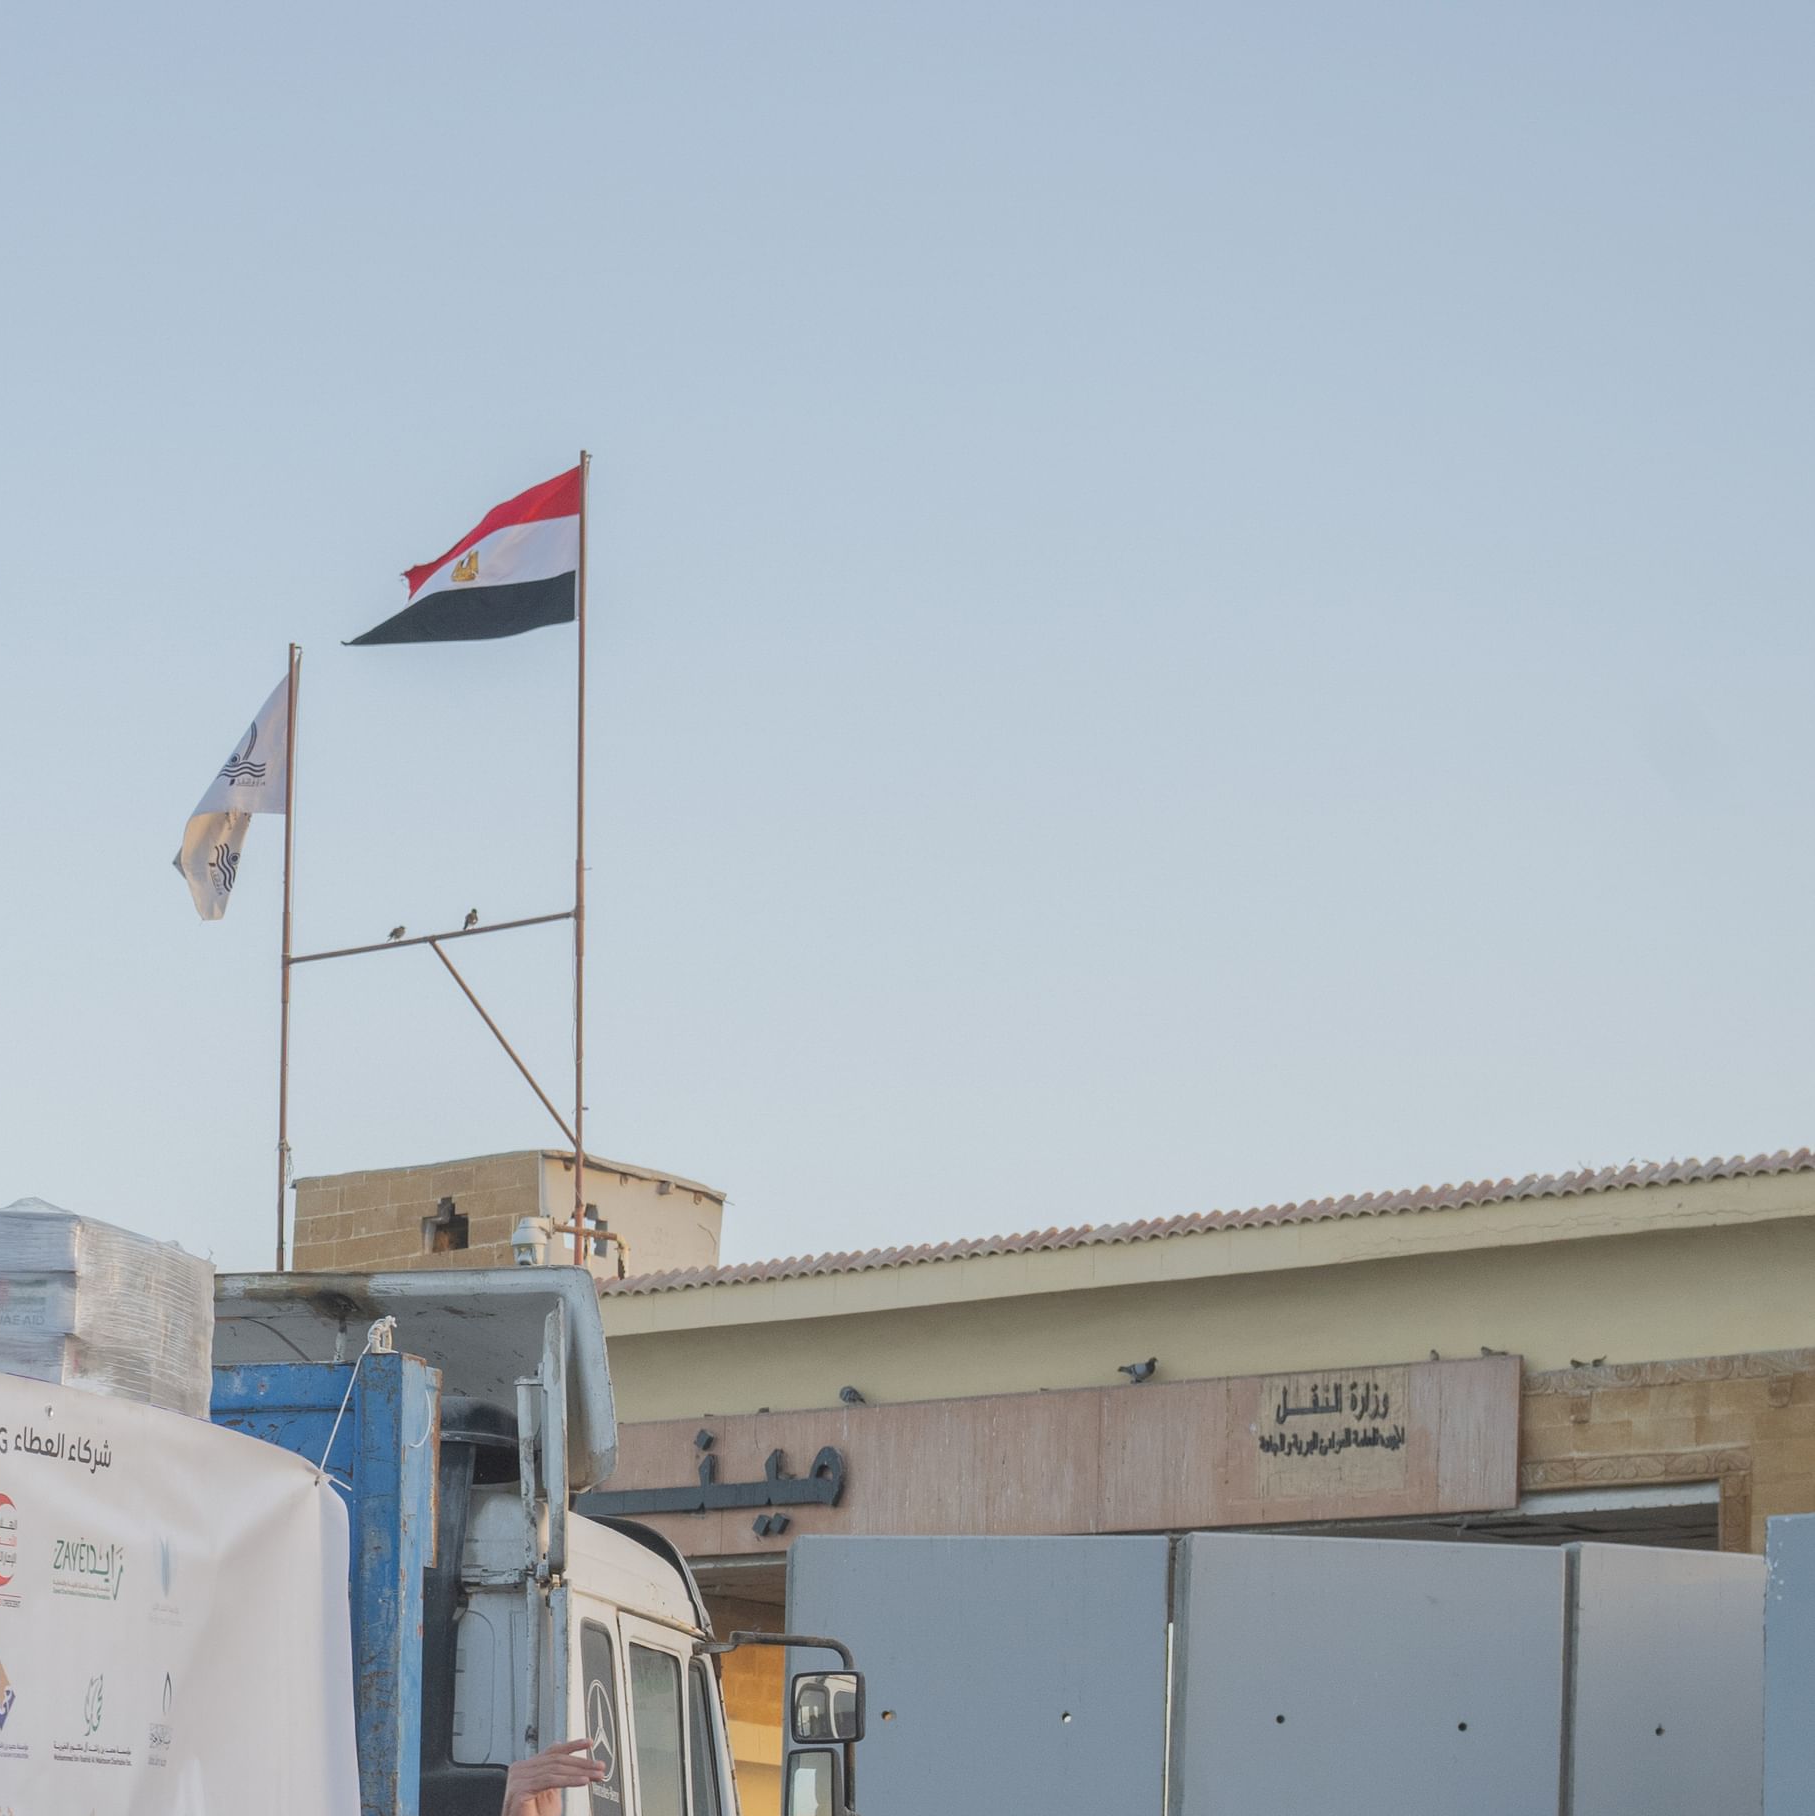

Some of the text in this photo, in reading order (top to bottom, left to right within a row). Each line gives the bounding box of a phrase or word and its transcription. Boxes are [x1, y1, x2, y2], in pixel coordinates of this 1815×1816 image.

[1276, 1380, 1390, 1425] وزارة النقل
[14, 1426, 112, 1474] شركاء العطاء
